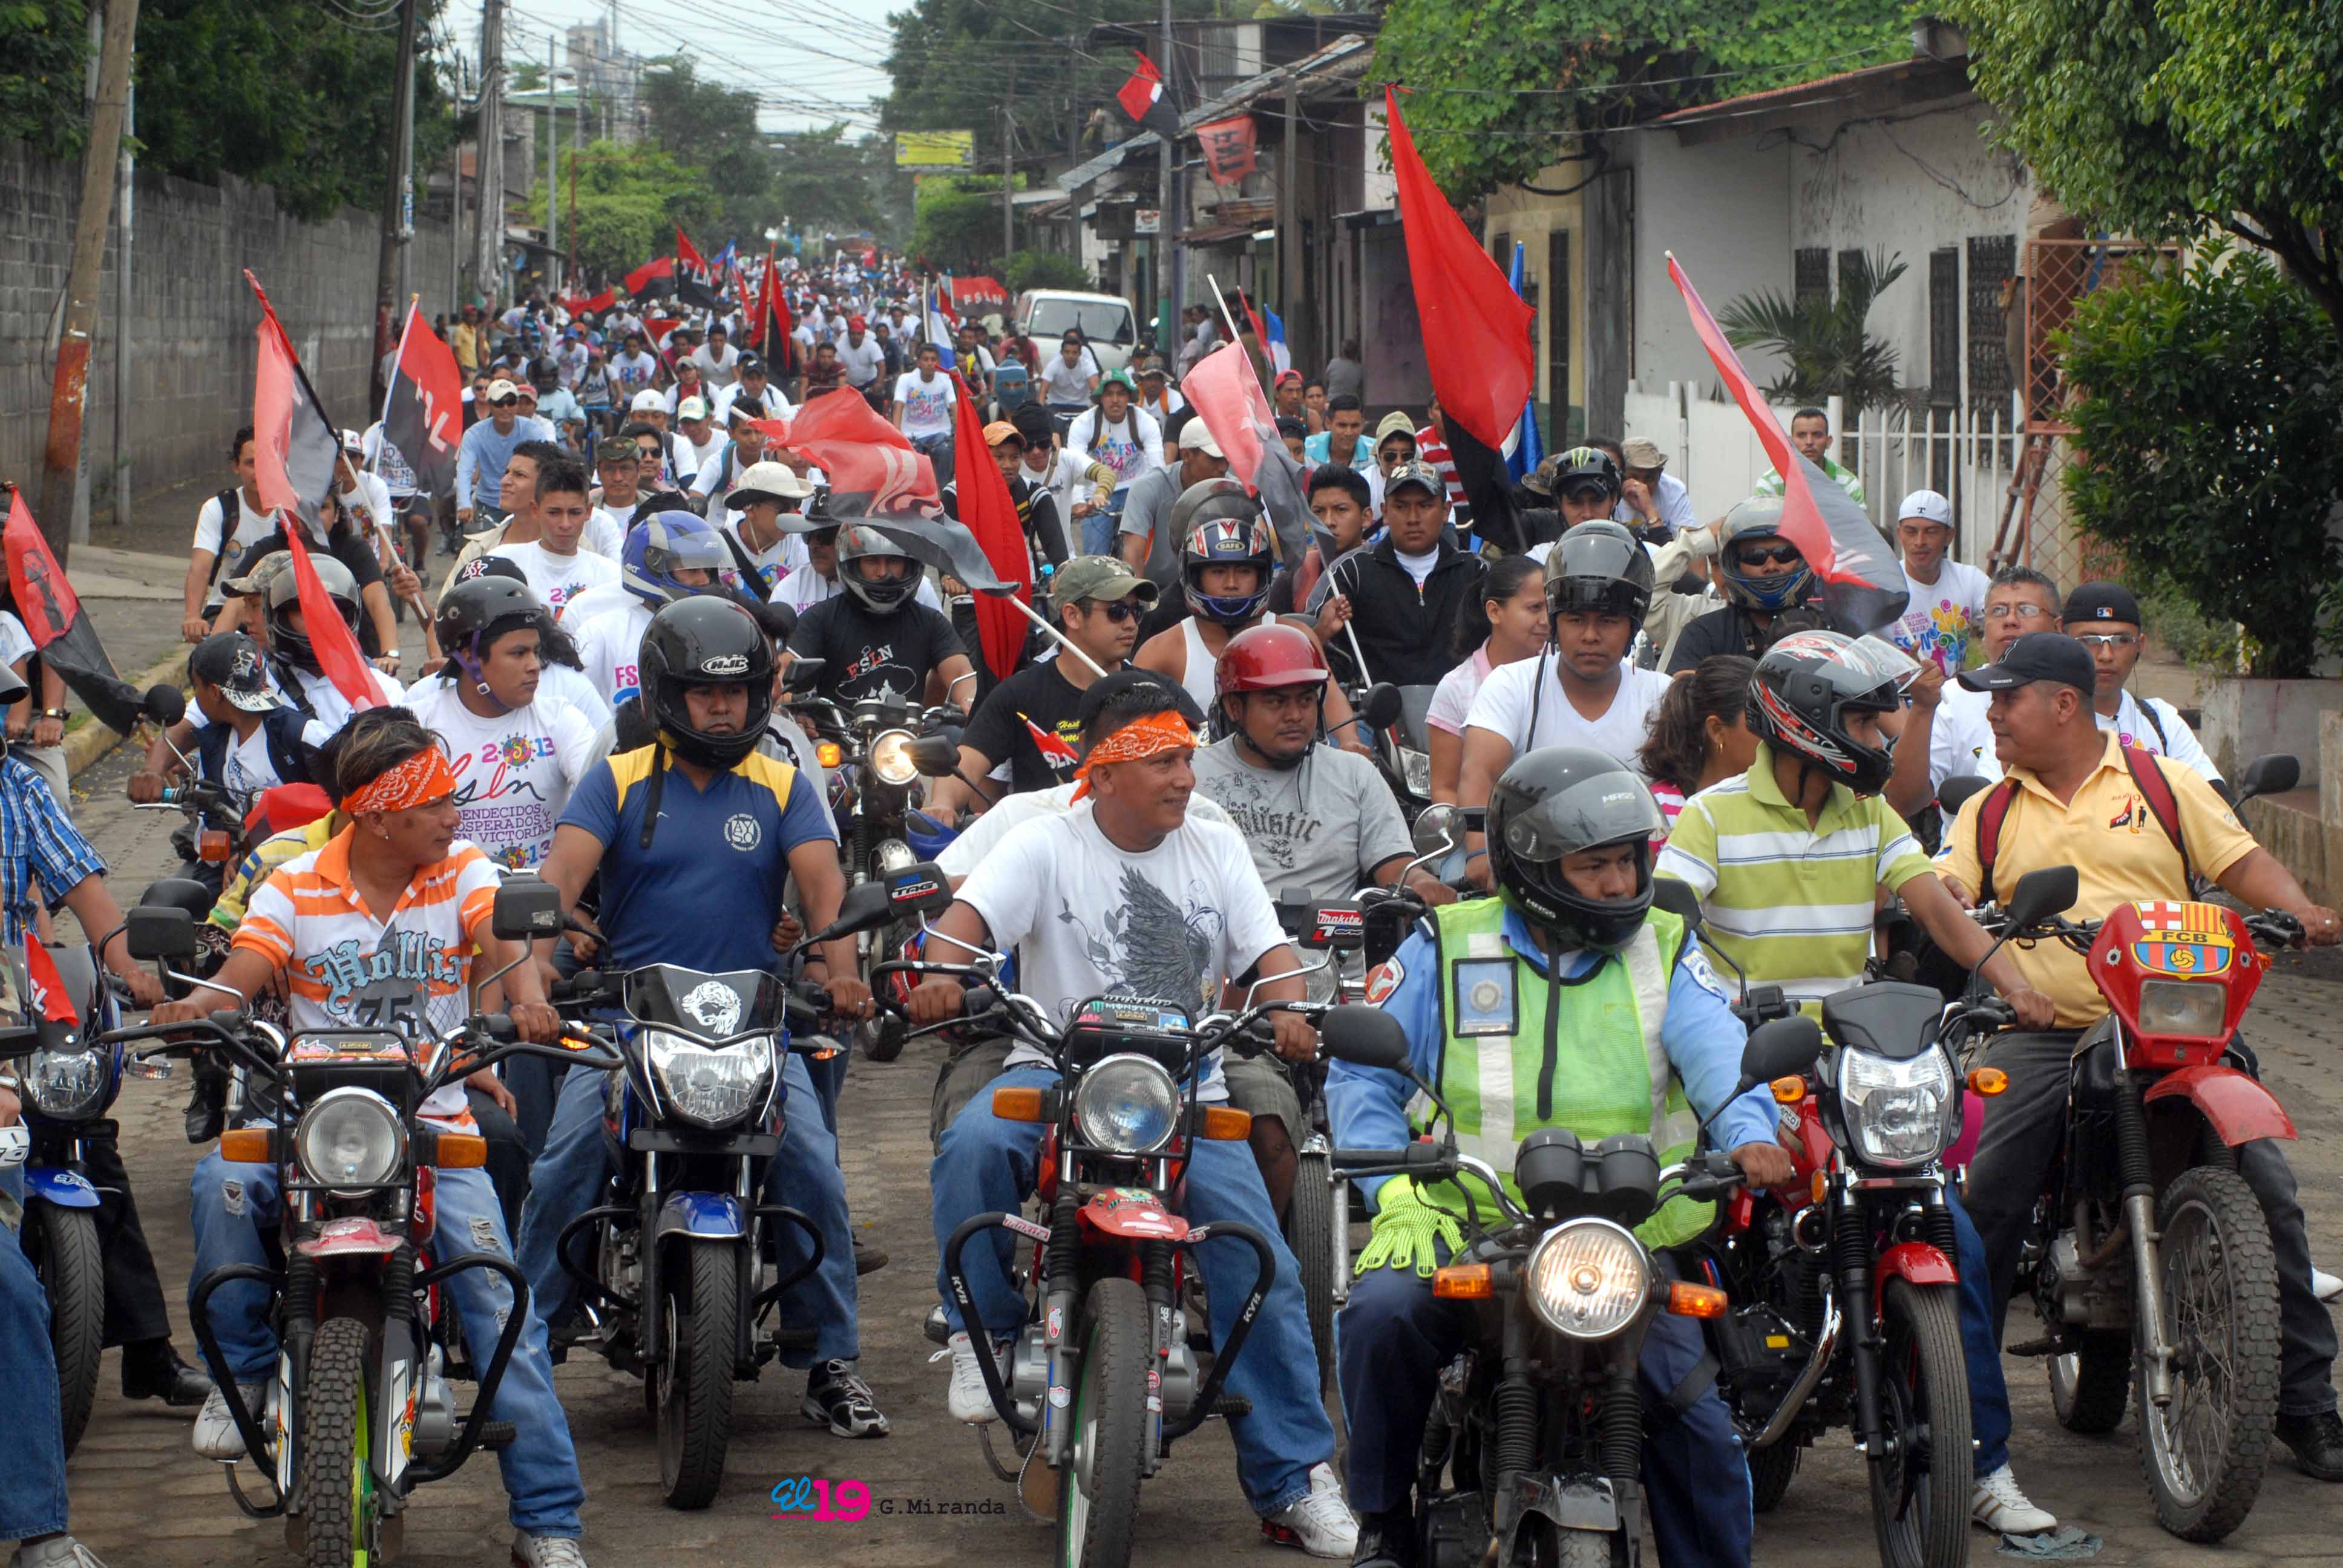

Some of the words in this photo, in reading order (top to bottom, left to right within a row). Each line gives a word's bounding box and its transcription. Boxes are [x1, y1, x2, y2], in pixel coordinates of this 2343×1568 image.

[963, 291, 1003, 305] FSLN
[709, 658, 747, 670] HJC
[846, 644, 894, 678] FSLN
[1602, 792, 1636, 803] MASS
[479, 821, 552, 843] VICTORIAS
[1525, 898, 1556, 919] MASS
[2161, 931, 2208, 943] FCB
[356, 995, 419, 1039] 75
[1105, 1002, 1159, 1015] MONSTER
[951, 1276, 968, 1304] KYB
[1243, 1292, 1262, 1323] KYB
